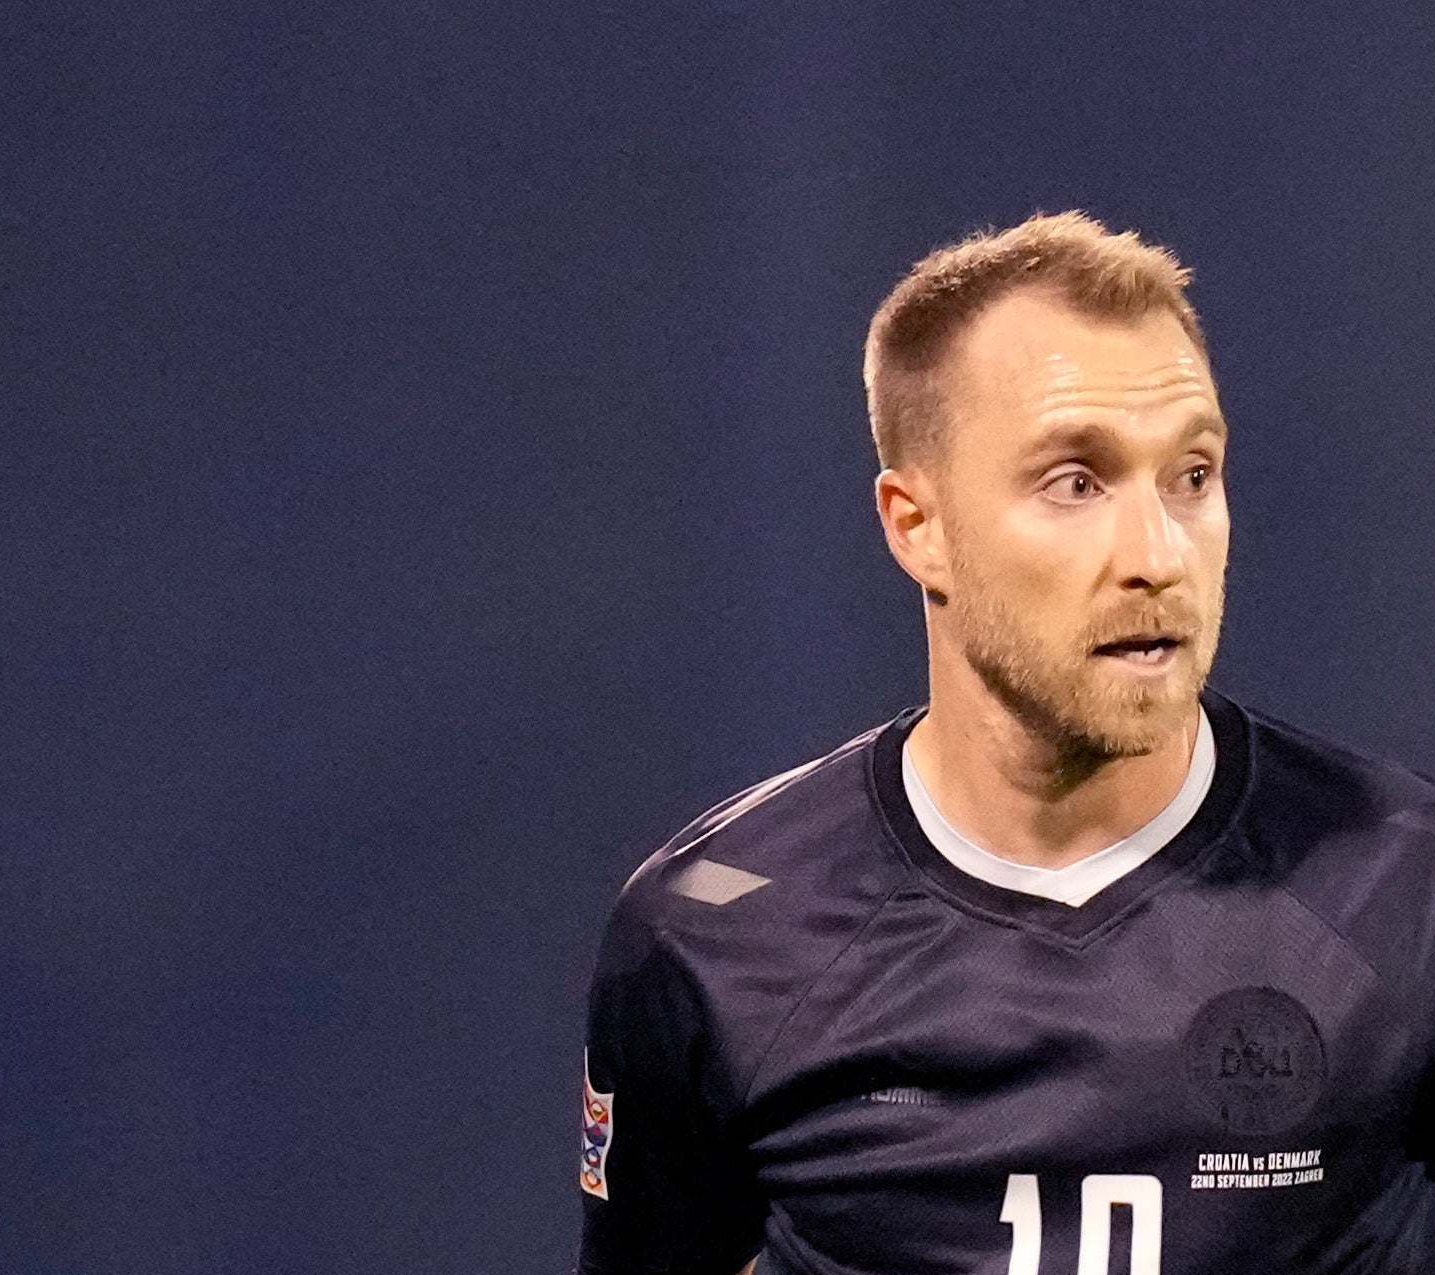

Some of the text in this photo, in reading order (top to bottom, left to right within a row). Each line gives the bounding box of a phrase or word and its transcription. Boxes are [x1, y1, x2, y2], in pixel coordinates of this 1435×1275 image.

[1198, 1149, 1322, 1171] CROATIA vs DENMARK
[1191, 1168, 1324, 1189] 22ND SEPTEMBER 2022 ZAGREB
